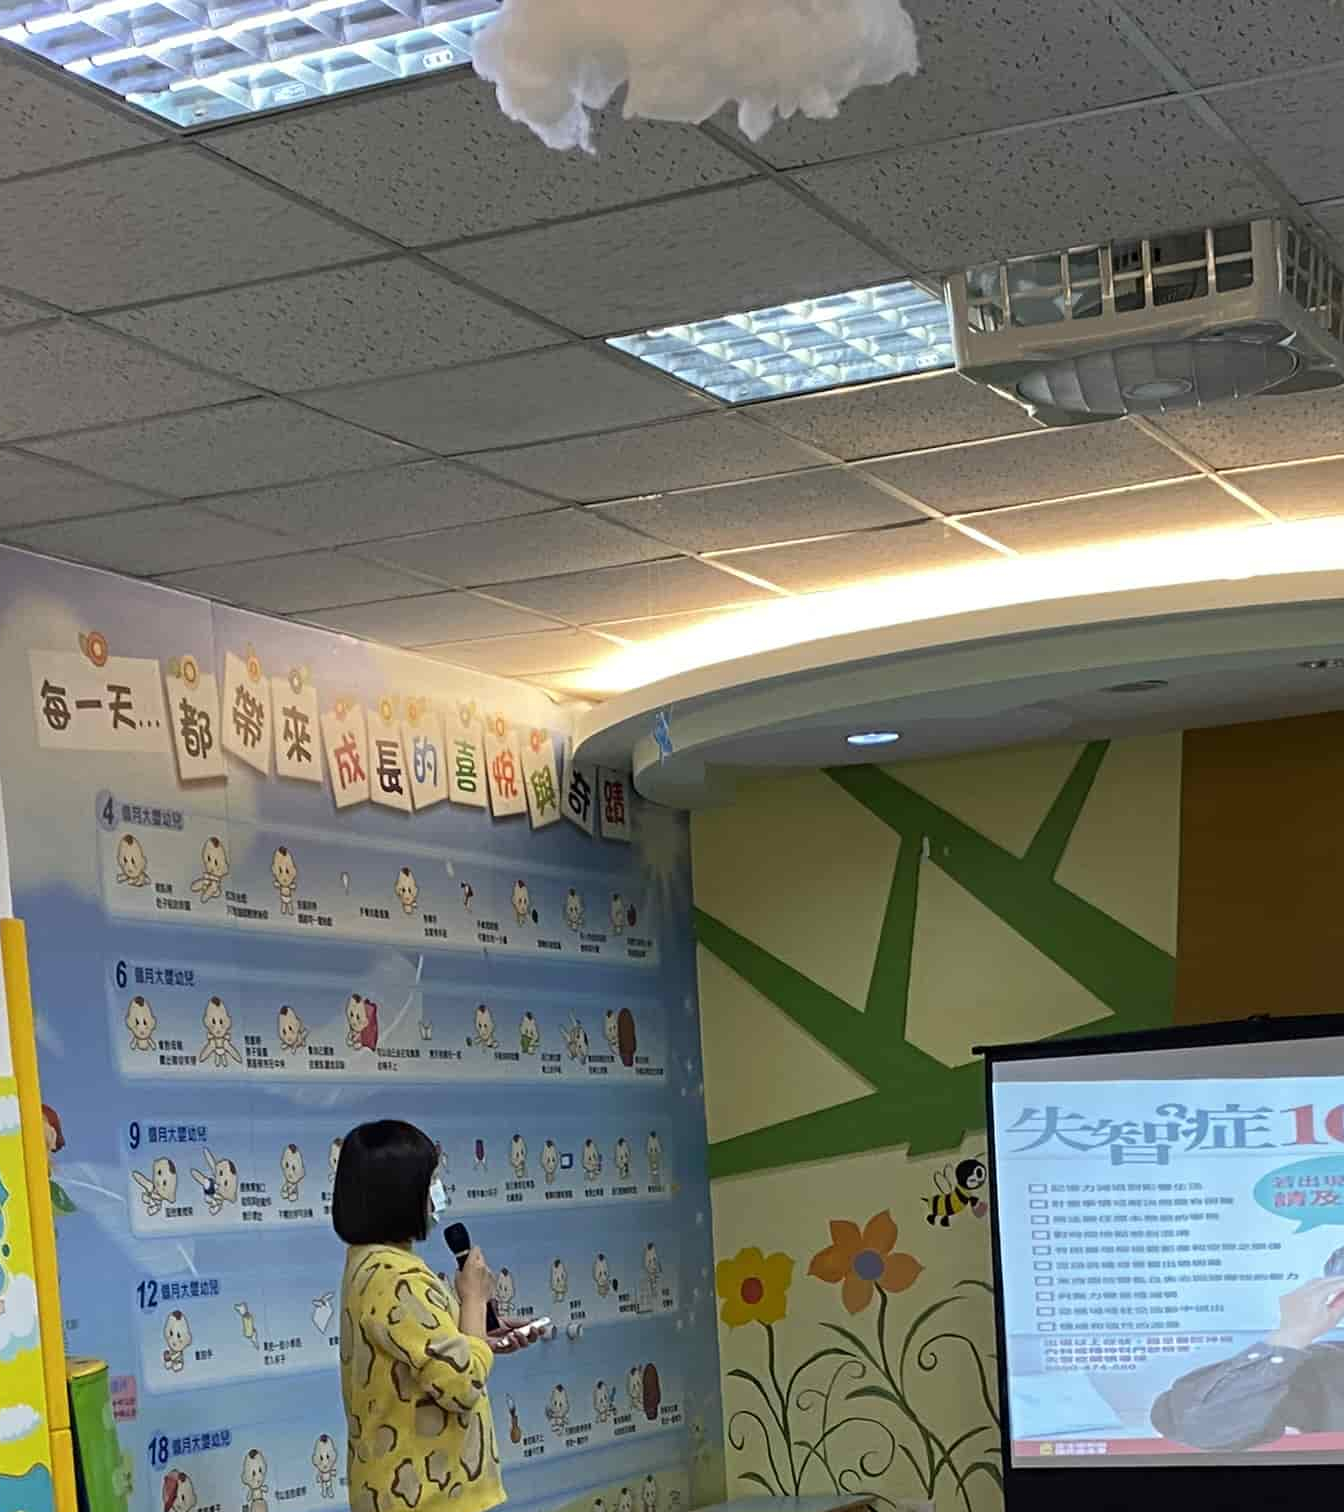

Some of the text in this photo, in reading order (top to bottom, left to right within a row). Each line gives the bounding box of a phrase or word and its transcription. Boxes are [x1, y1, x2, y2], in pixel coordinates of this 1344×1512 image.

[102, 796, 116, 826] 4
[115, 960, 128, 989] 6
[128, 1121, 141, 1150] 9
[136, 1280, 159, 1309] 12
[147, 1436, 170, 1466] 18
